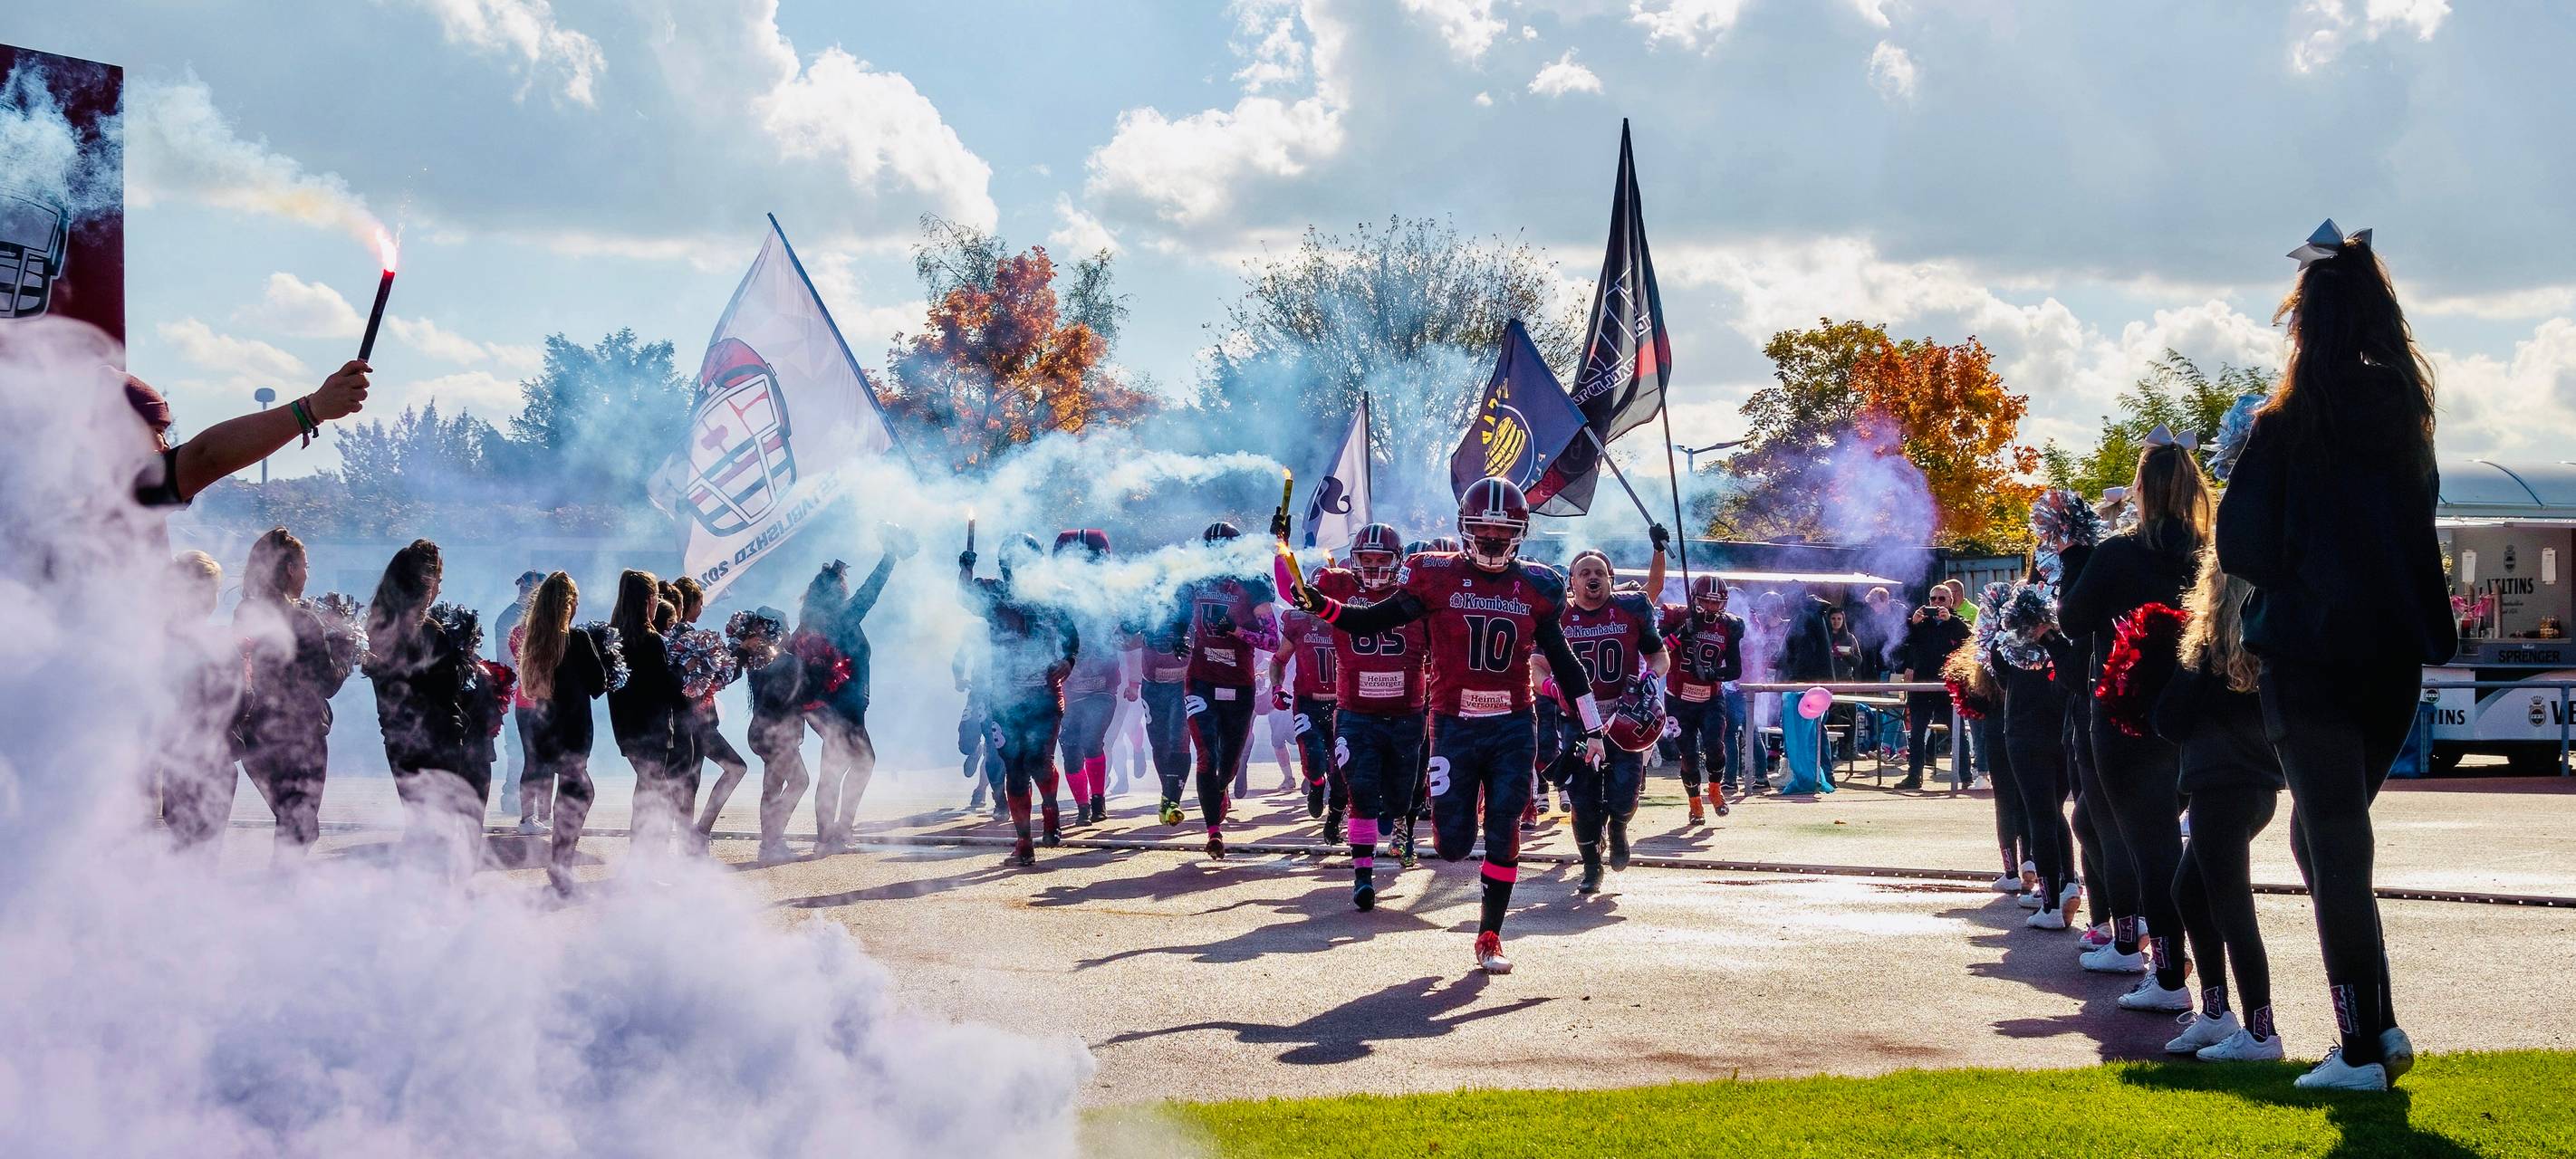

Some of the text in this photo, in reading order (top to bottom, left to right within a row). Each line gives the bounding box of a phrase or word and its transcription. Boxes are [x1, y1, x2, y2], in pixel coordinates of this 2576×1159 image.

[2487, 578, 2534, 595] VLTINS
[1463, 592, 1532, 616] Krombacher
[1573, 622, 1628, 637] Krombacher
[1463, 614, 1518, 673] 10
[1571, 637, 1624, 684] 50
[2498, 650, 2561, 664] SPRENGER
[1363, 681, 1405, 689] versorger
[1466, 701, 1508, 710] versorger
[1470, 694, 1505, 703] Heimat
